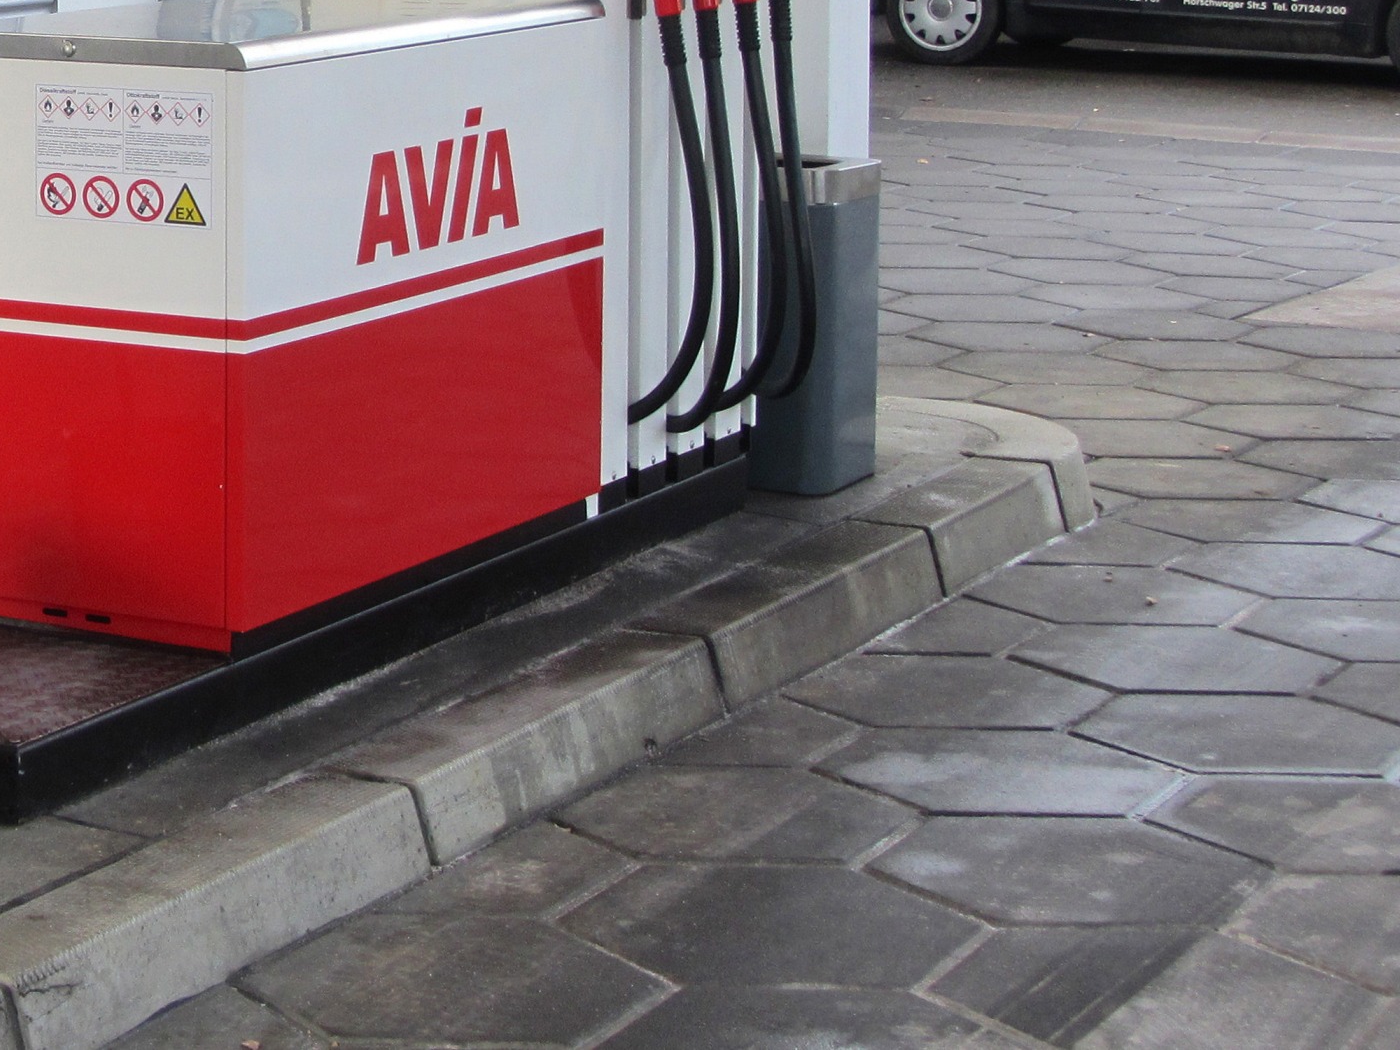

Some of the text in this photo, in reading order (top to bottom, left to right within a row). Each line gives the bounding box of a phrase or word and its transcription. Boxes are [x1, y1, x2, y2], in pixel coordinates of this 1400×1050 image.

[1273, 2, 1287, 12] Tel.
[1291, 4, 1347, 15] 07124/300
[176, 207, 195, 220] EX
